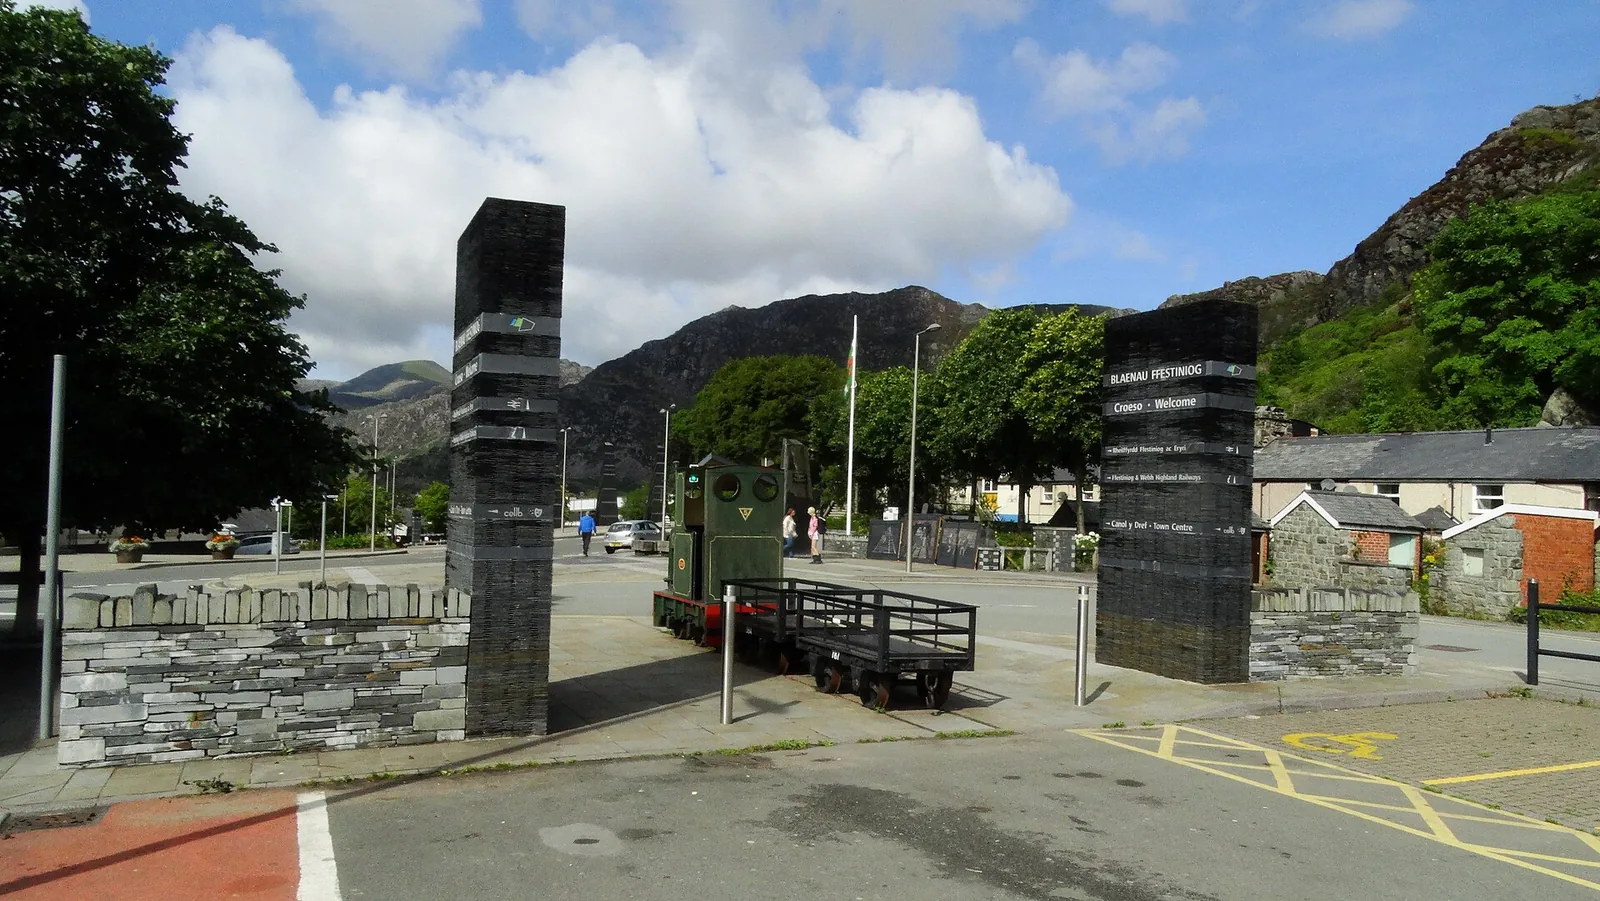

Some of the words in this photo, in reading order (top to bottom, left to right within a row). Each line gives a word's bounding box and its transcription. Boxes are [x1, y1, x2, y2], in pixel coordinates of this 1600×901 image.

[1110, 371, 1149, 384] BLAENAU
[1151, 364, 1202, 380] FFESTINIOG
[1114, 402, 1143, 413] Croeso
[1154, 397, 1197, 409] Welcome
[1155, 474, 1177, 482] Highland
[1178, 474, 1202, 482] Railways
[1111, 519, 1128, 529] Canol
[1128, 521, 1133, 530] y
[1134, 521, 1148, 529] Dref
[1153, 522, 1170, 531] Town
[1171, 523, 1194, 532] Centre
